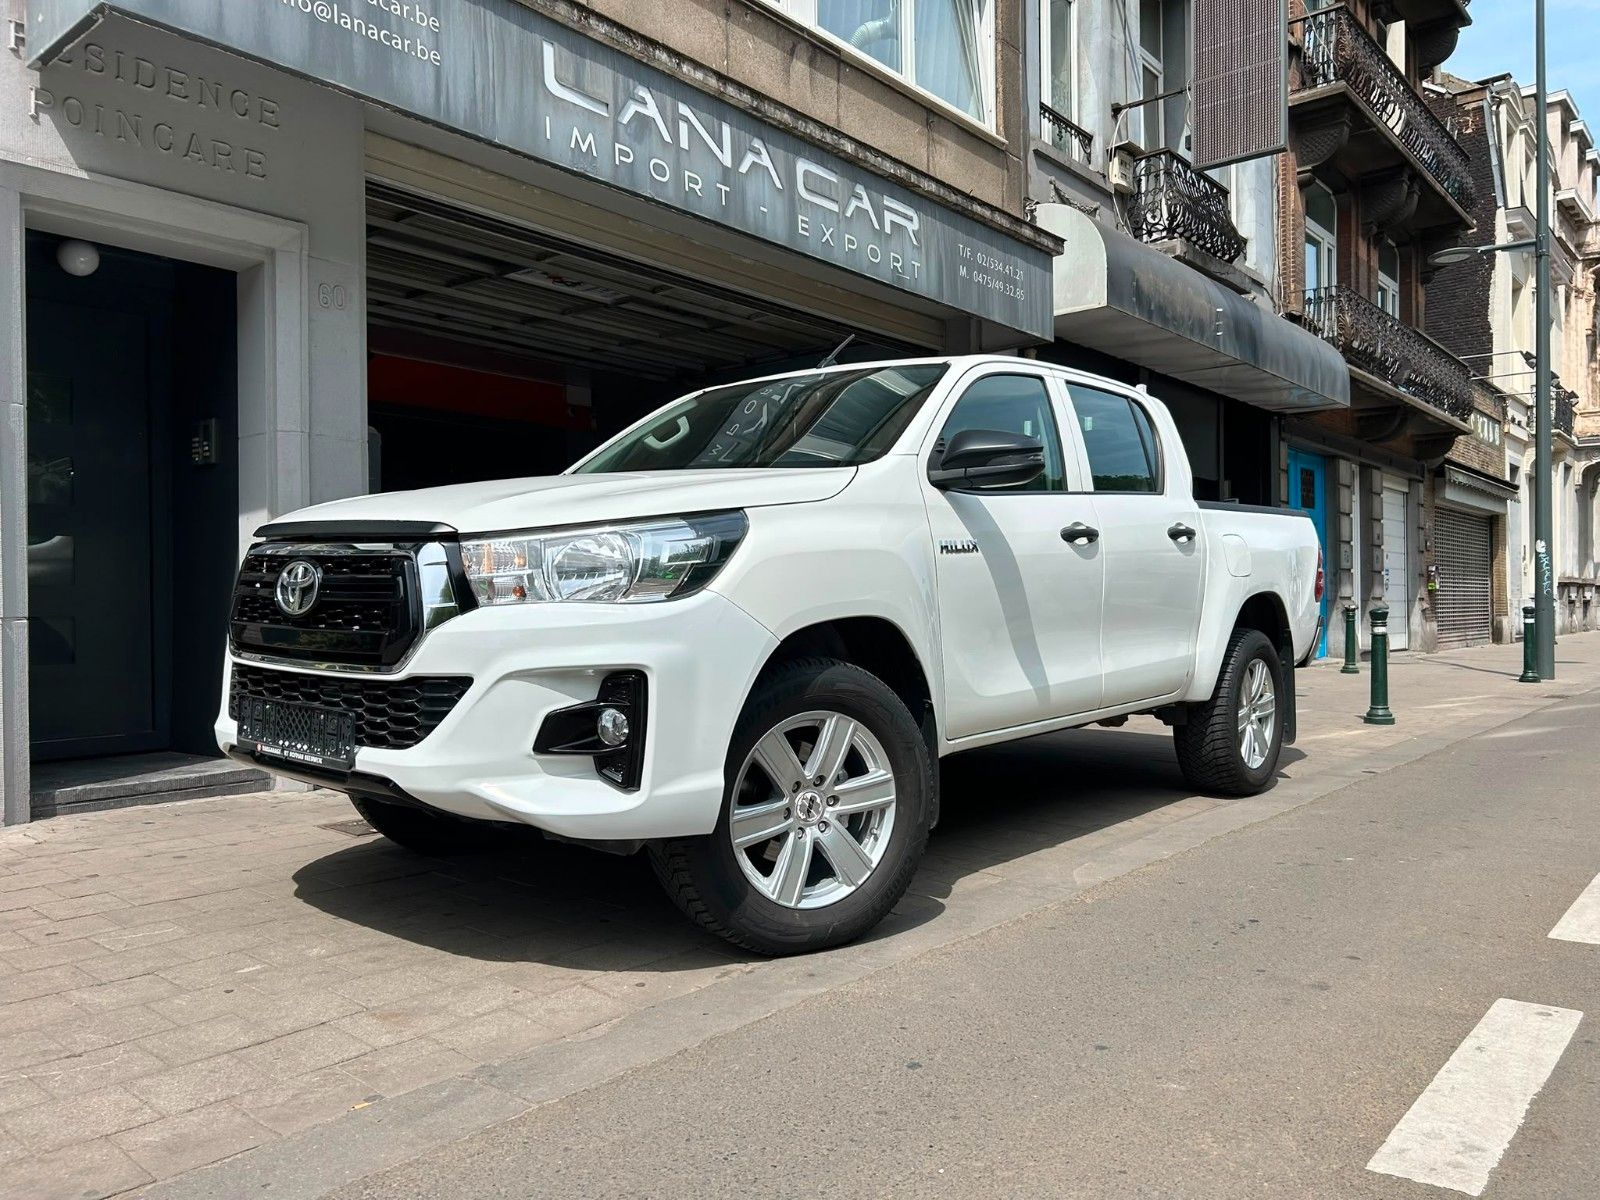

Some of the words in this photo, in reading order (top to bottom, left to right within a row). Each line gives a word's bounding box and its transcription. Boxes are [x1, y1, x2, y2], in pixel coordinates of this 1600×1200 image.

[282, 0, 441, 66] o@lanacar.be
[8, 20, 280, 128] SIDENCE
[28, 86, 267, 179] POINCARE
[545, 115, 730, 206] IMPORT
[798, 214, 921, 279] EXPORT
[958, 244, 974, 261] T/F.
[977, 252, 1024, 281] 02/534.41.21
[959, 265, 970, 279] M.
[973, 271, 1025, 301] 0475/49.32.85
[318, 282, 345, 310] 60
